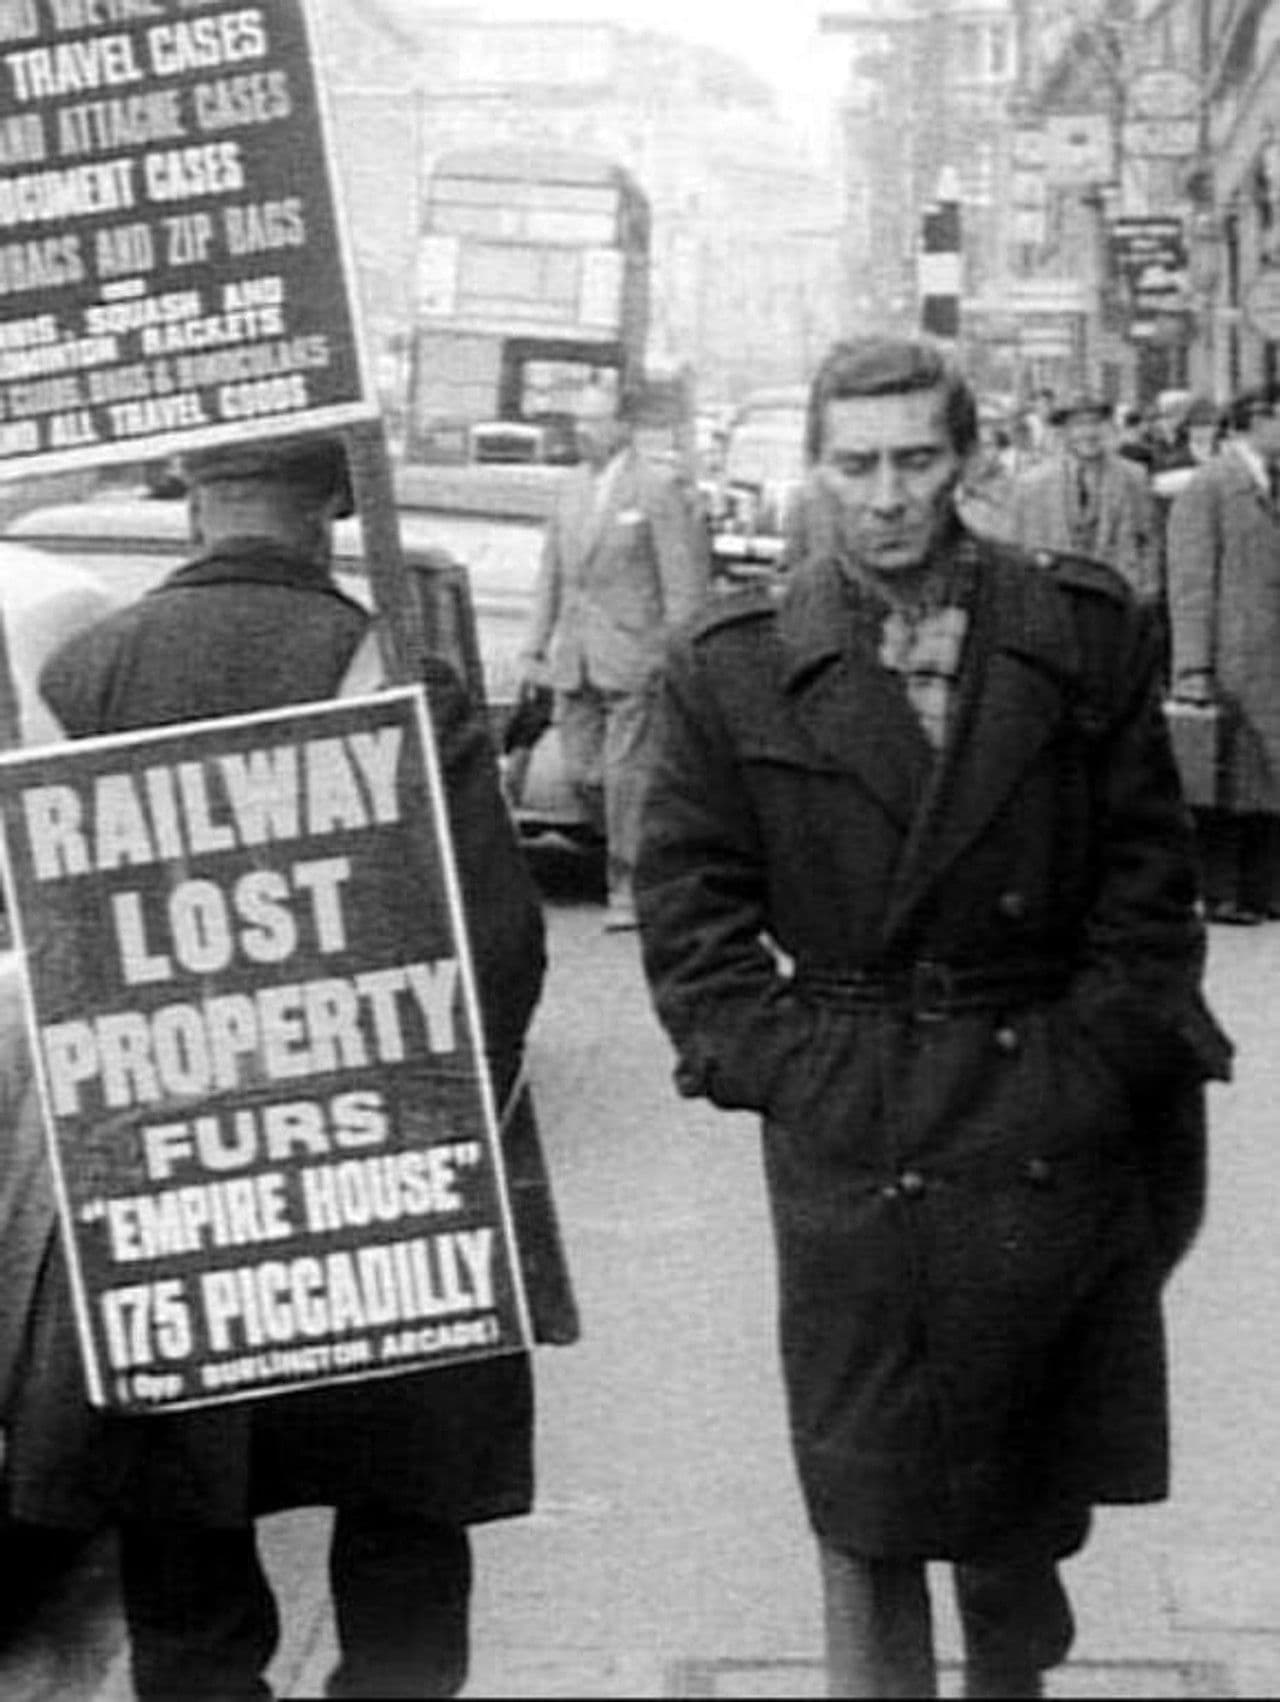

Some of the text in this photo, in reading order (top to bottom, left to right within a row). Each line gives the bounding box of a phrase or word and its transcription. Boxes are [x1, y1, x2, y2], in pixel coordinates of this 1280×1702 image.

[4, 34, 143, 101] TRAVEL
[147, 9, 266, 76] CASES
[194, 71, 291, 131] CASES
[145, 142, 244, 201] CASES
[96, 223, 153, 276] AND
[160, 213, 212, 267] ZIP
[224, 198, 305, 255] BAGS
[85, 290, 200, 335] SQUASH
[223, 276, 284, 312] AND
[142, 307, 285, 355] RACKETS
[51, 410, 99, 447] ALL
[108, 392, 210, 438] TRAVEL
[21, 726, 402, 881] RAILWAY
[110, 857, 351, 985] LOST
[42, 959, 459, 1117] PROPERTY
[142, 1091, 389, 1180] FURS
[102, 1228, 494, 1370] 175 PICCADILLY
